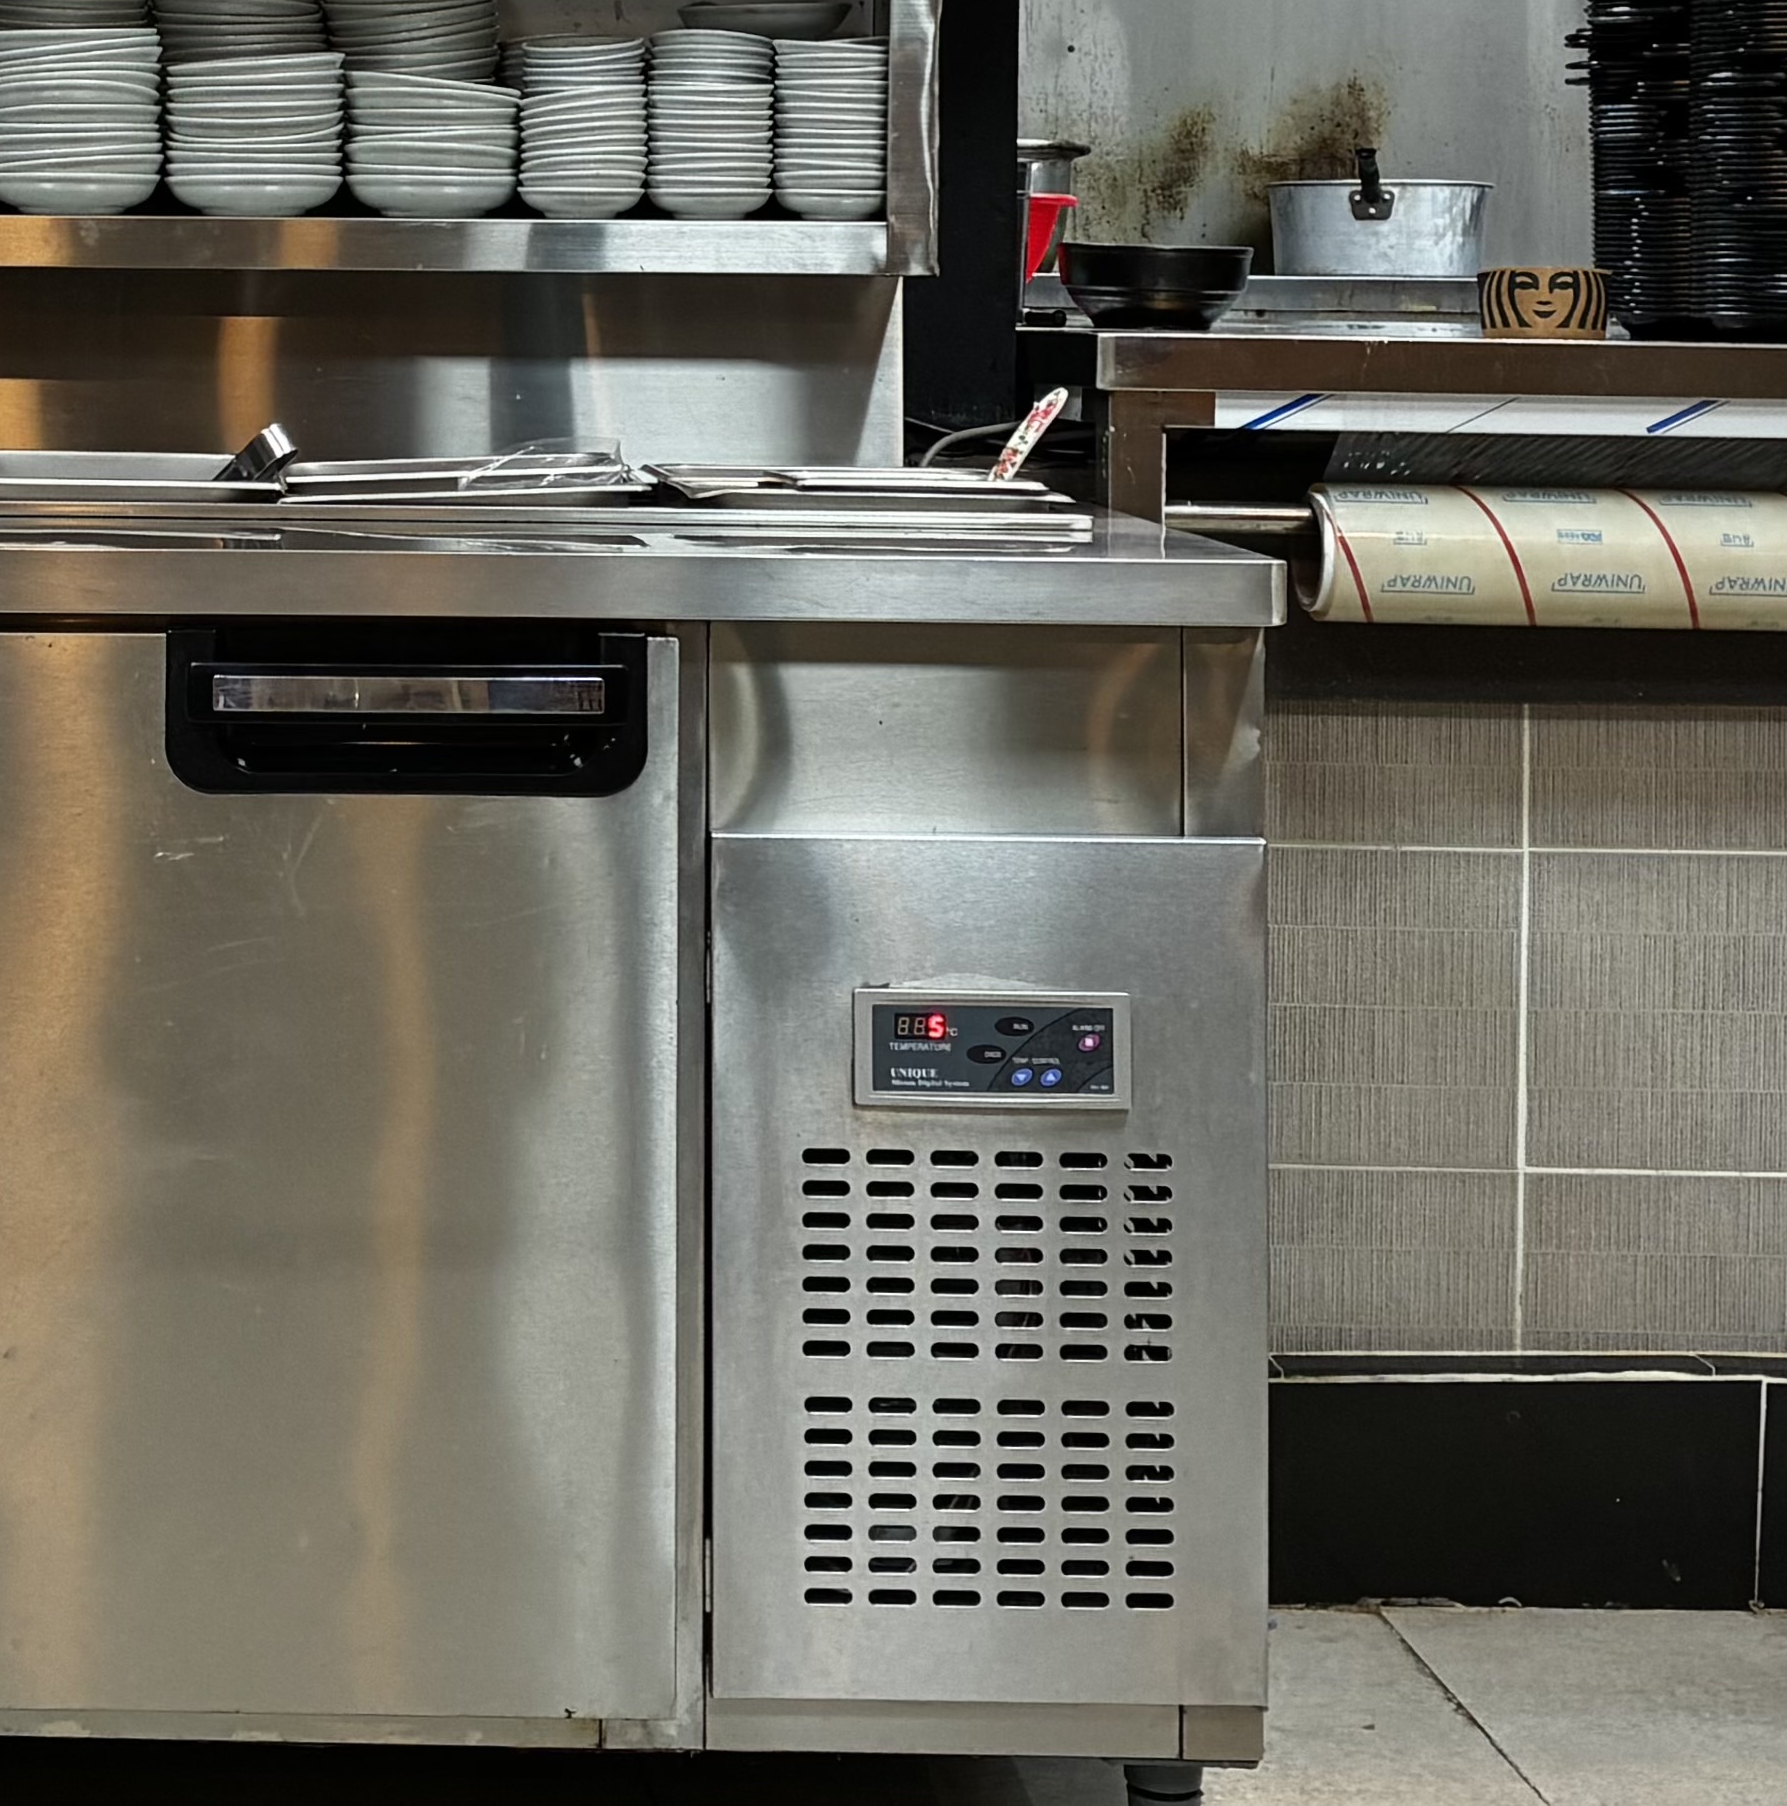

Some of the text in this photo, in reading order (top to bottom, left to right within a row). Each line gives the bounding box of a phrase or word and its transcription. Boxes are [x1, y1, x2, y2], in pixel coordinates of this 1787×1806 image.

[1385, 574, 1473, 593] UNIWRAP
[1555, 573, 1643, 592] UNIWRAP
[890, 1068, 938, 1079] UNIQUE
